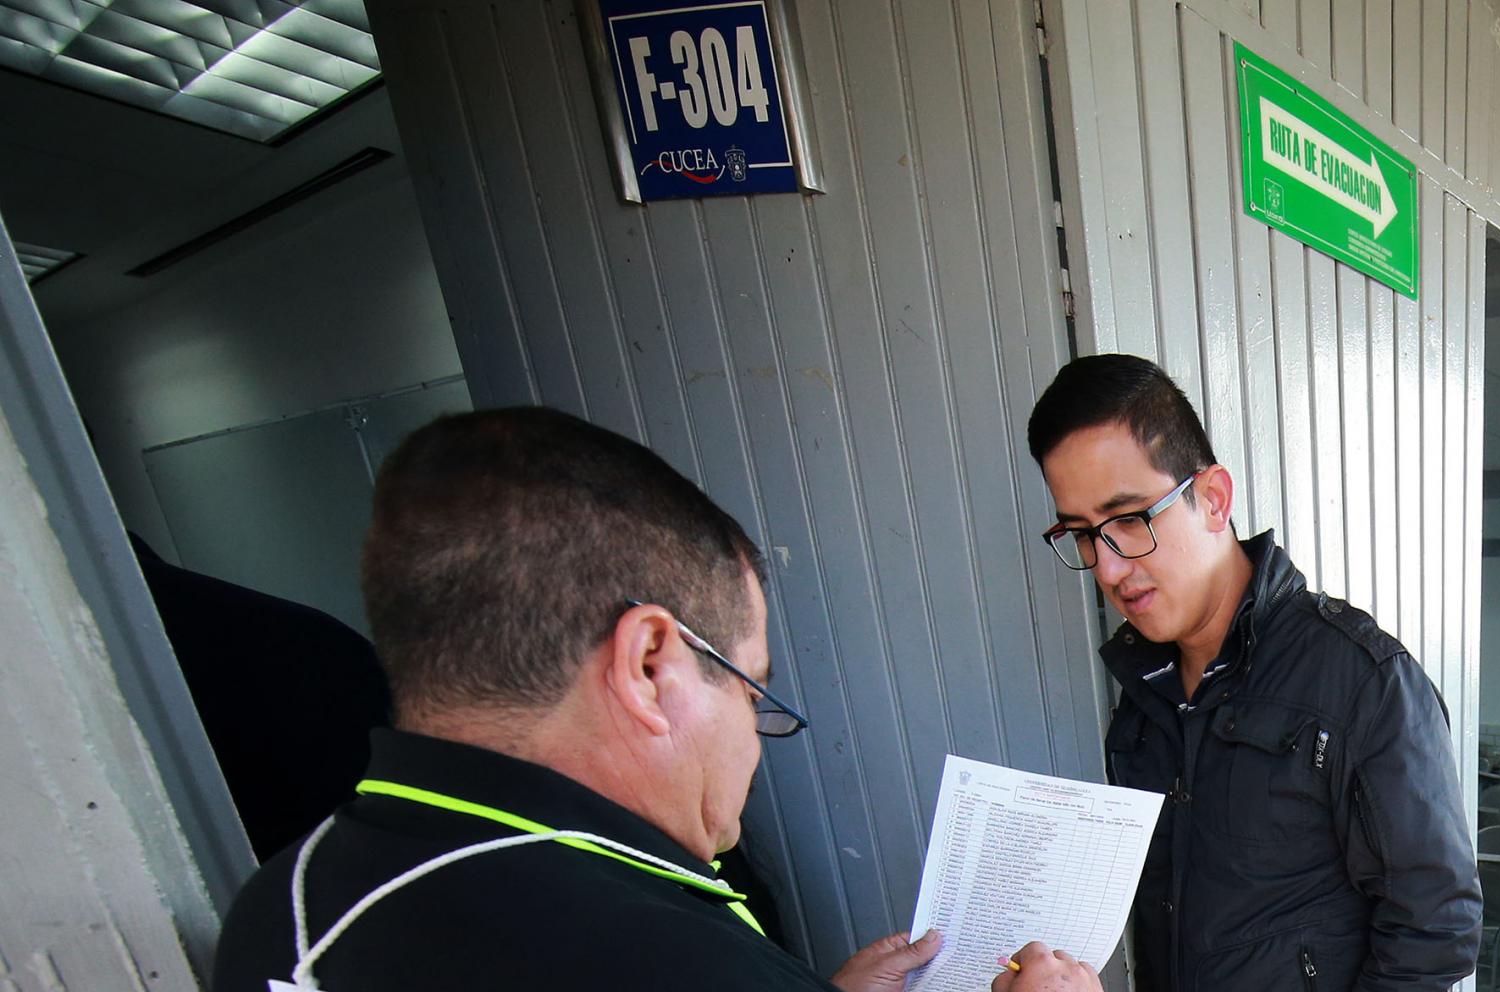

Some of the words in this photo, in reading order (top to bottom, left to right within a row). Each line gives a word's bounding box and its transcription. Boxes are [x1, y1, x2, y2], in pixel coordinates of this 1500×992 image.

[629, 26, 769, 131] F-304
[659, 149, 719, 173] CUCEA
[1269, 117, 1301, 167] RUTA
[1304, 138, 1318, 176] DE
